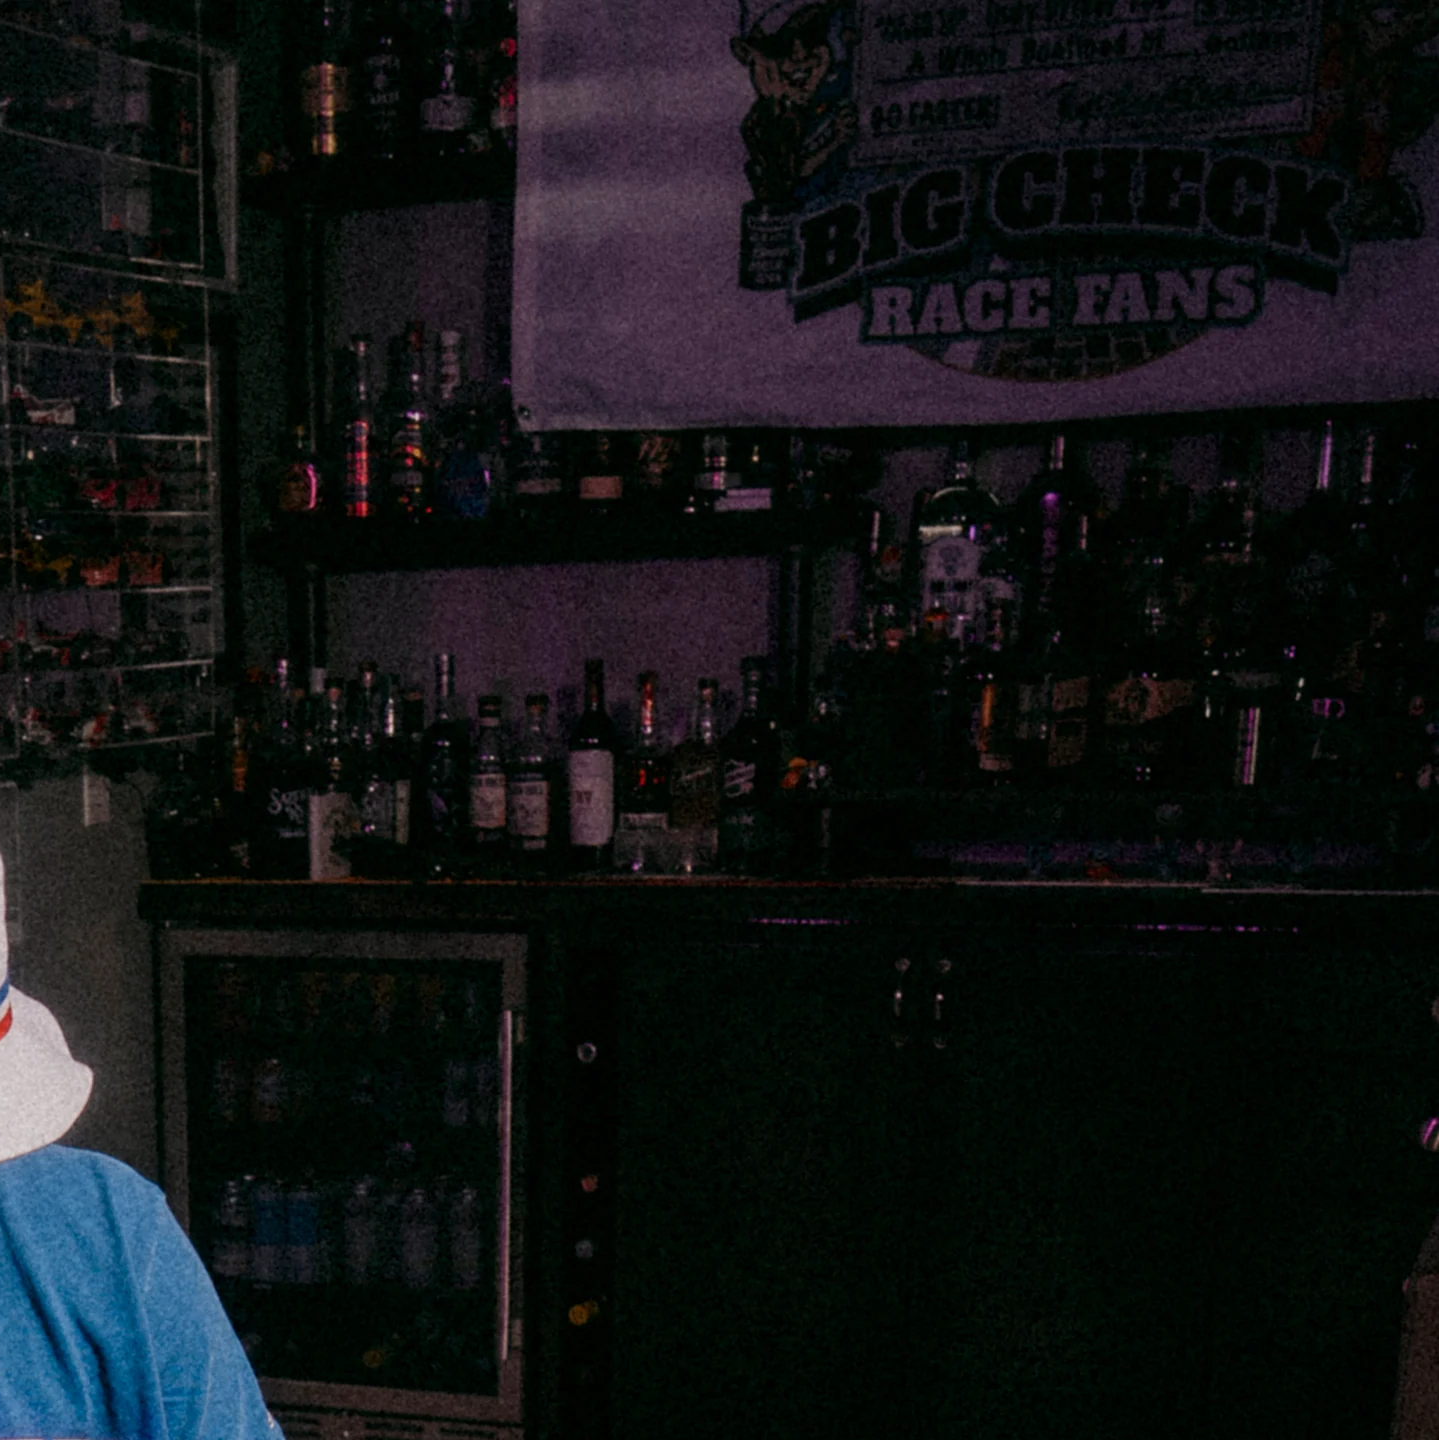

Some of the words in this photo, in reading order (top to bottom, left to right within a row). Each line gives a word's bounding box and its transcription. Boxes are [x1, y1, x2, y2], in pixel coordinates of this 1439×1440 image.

[796, 167, 966, 290] BIG
[994, 148, 1346, 261] CHECK
[868, 277, 1052, 338] RACE
[1072, 264, 1257, 326] FANS
